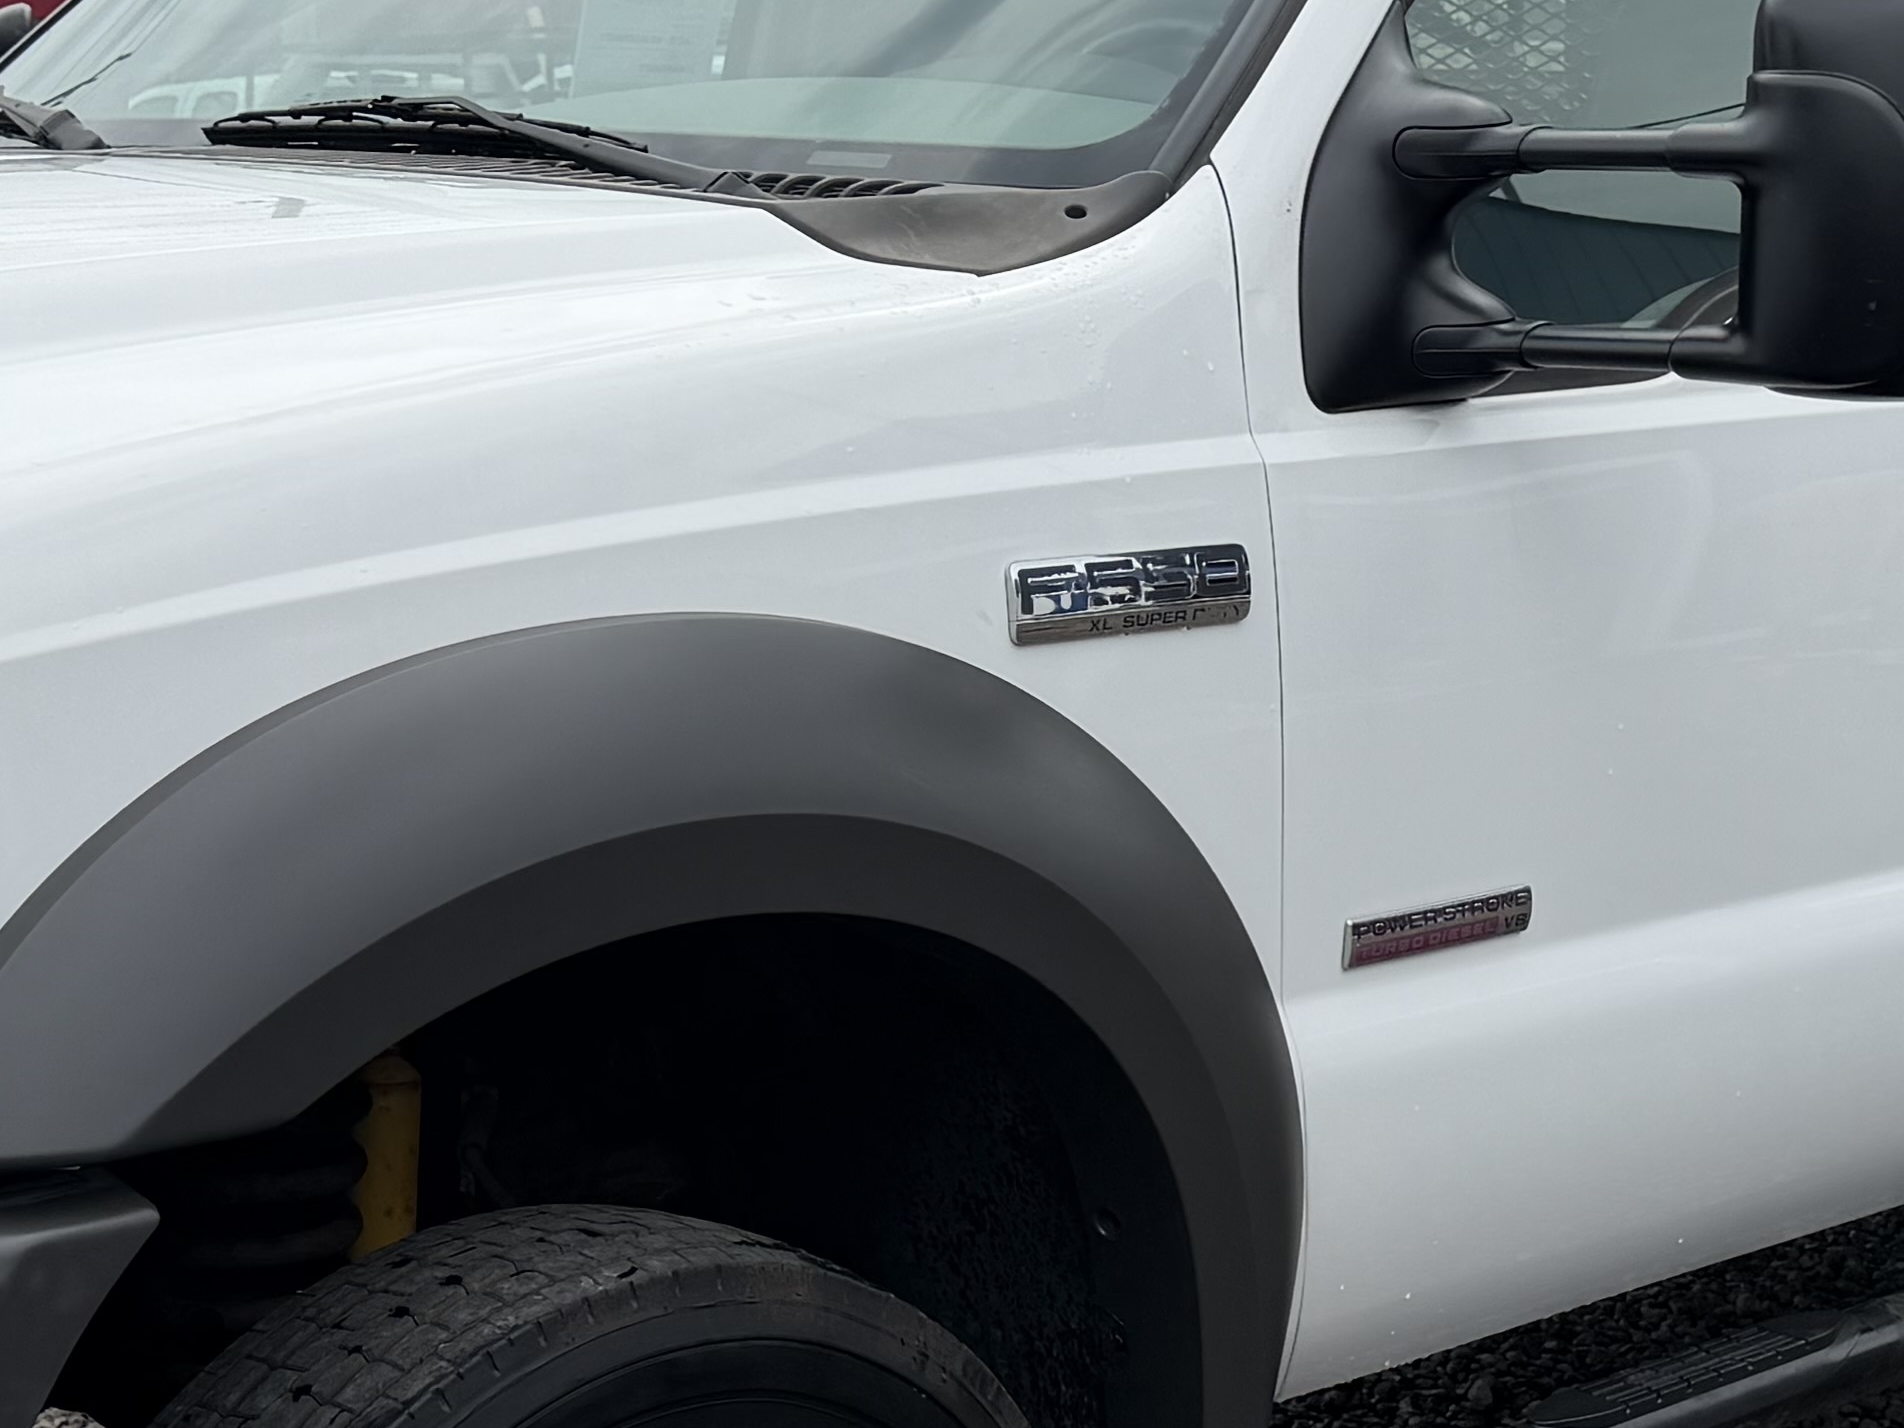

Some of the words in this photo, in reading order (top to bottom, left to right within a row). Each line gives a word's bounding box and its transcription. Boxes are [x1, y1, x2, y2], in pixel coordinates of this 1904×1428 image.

[1088, 618, 1114, 633] XL
[1122, 610, 1188, 629] SUPER
[1357, 936, 1425, 960] TURBO
[1428, 920, 1498, 945] DIESEL
[1503, 911, 1529, 930] V8
